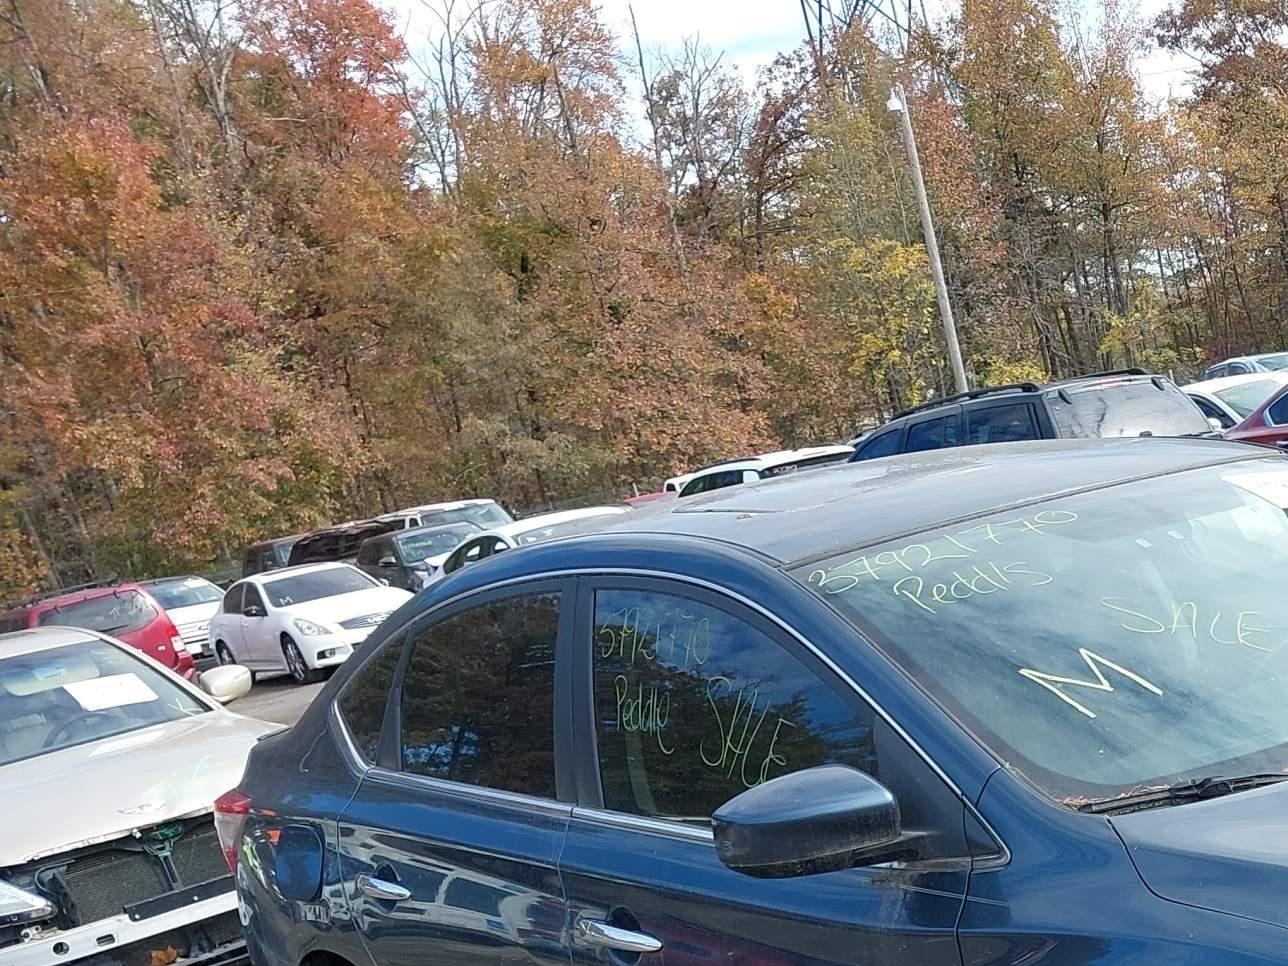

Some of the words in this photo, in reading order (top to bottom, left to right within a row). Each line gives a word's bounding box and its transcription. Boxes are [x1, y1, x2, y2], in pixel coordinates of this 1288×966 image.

[808, 510, 1079, 595] 37921770
[279, 595, 294, 607] M
[1017, 647, 1164, 720] M
